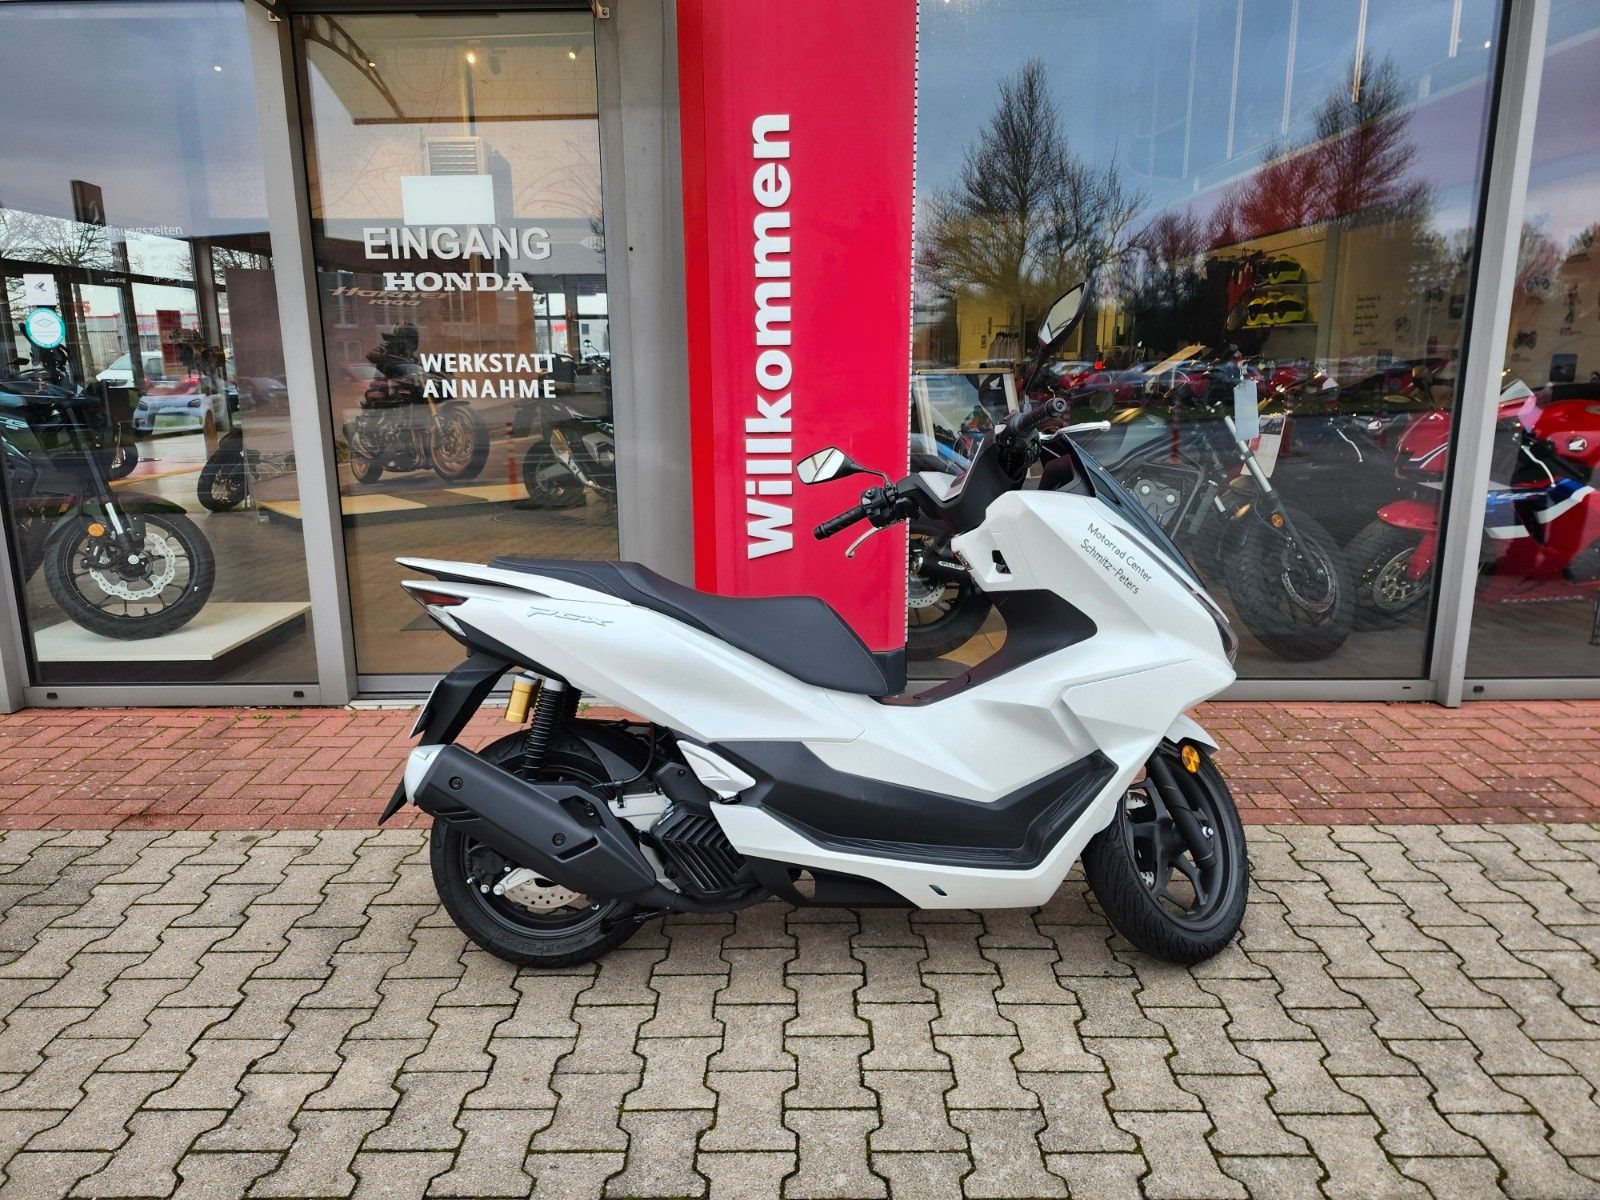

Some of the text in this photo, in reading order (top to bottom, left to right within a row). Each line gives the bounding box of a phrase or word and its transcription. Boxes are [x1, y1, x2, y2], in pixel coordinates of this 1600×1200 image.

[363, 227, 551, 261] EINGANG
[383, 272, 534, 292] HONDA
[745, 113, 794, 560] Willkommen
[420, 353, 557, 373] WERKSTATT
[422, 379, 557, 399] ANNAHME
[1080, 538, 1140, 594] Schmitz-Peters
[1087, 522, 1152, 582] Motorrad Center
